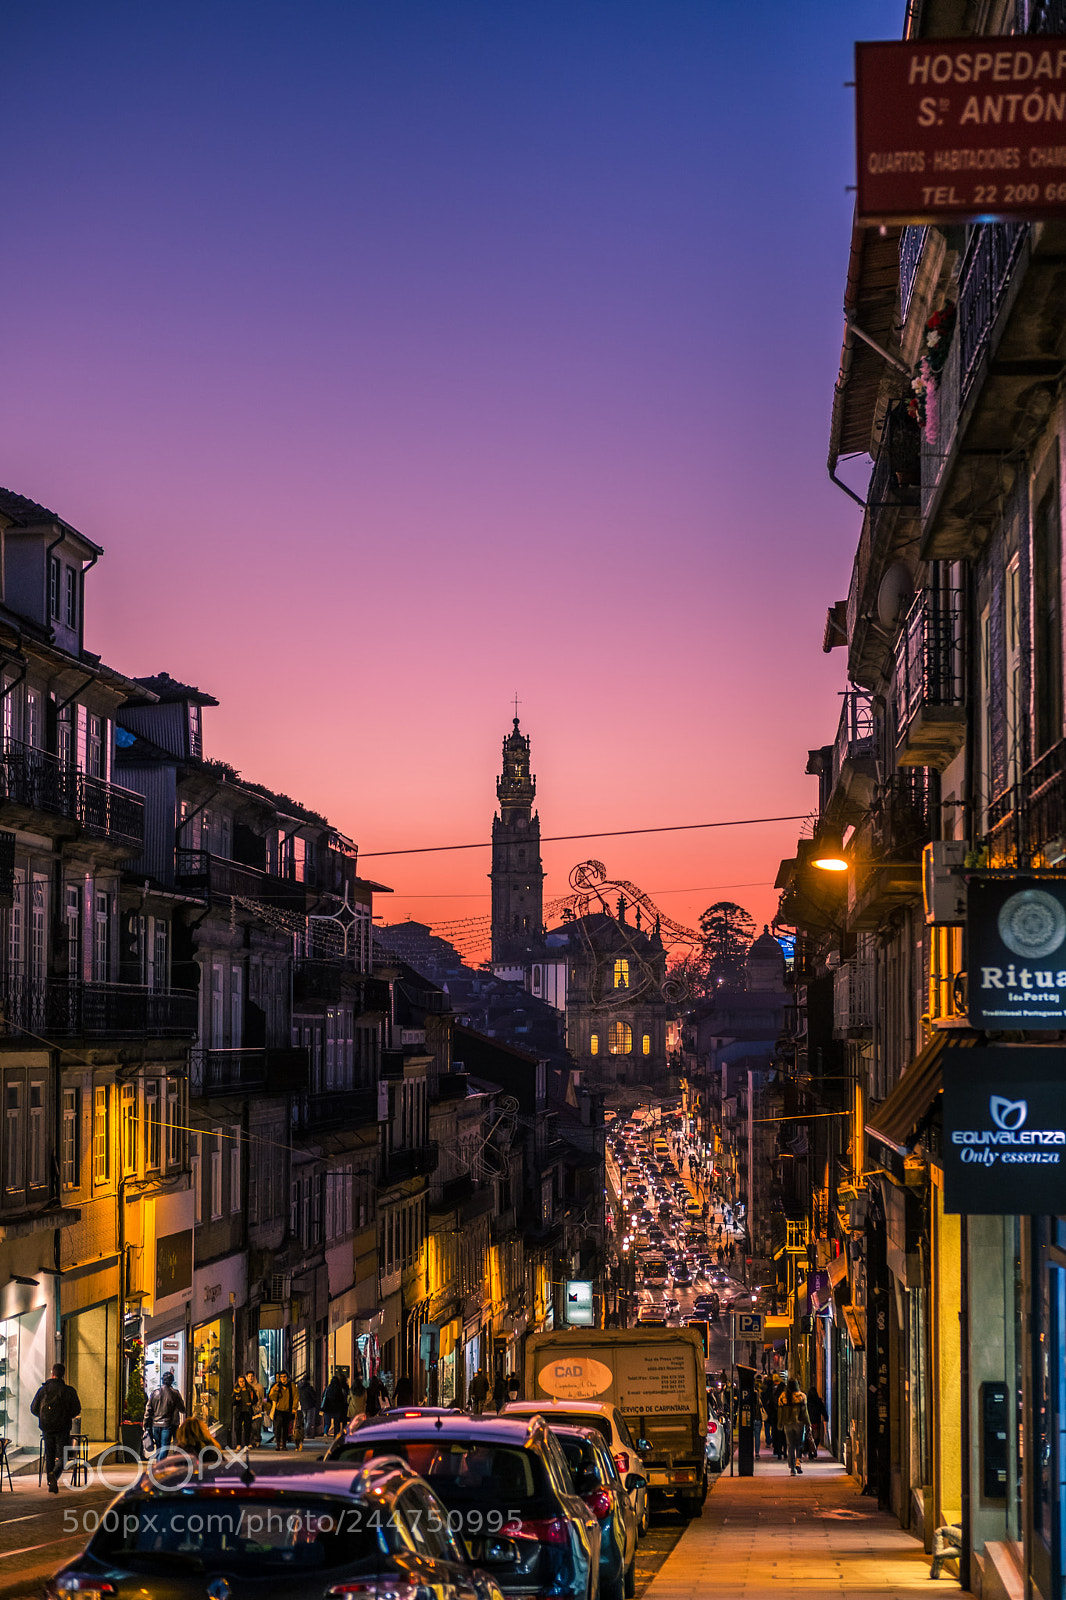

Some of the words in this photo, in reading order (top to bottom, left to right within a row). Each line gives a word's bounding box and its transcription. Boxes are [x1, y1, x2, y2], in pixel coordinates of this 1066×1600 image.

[908, 50, 1066, 84] HOSPEDAR
[960, 86, 1066, 125] ANTÓN
[868, 152, 925, 174] QUARTOS
[933, 148, 1020, 171] HABITACIONES
[921, 187, 965, 205] TEL.
[974, 185, 997, 203] 22
[1004, 184, 1039, 202] 200
[1045, 182, 1066, 201] 66
[981, 964, 1066, 989] Ritua
[960, 1146, 999, 1167] Only
[1001, 1152, 1060, 1163] essenza
[741, 1316, 753, 1331] P
[555, 1365, 582, 1378] CAD
[742, 1390, 749, 1399] P
[620, 1406, 644, 1414] SERVIÇO
[654, 1404, 690, 1412] CARPINTARIA
